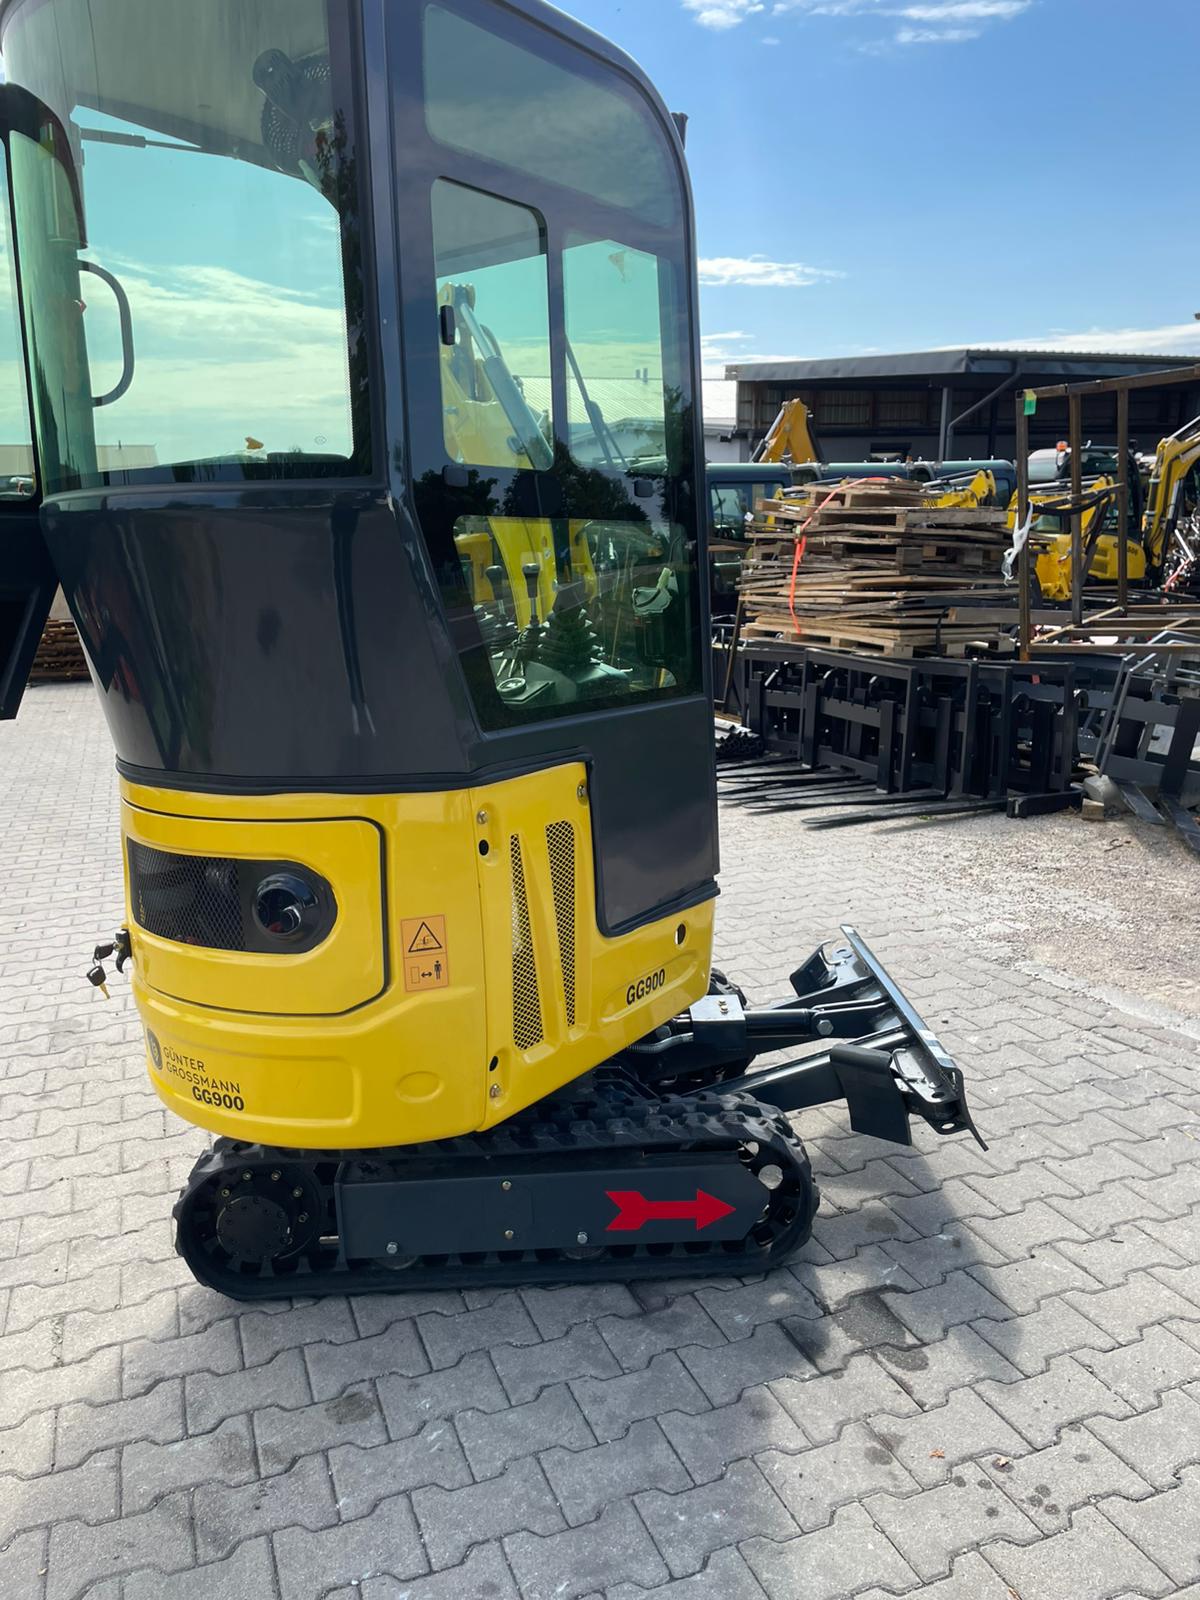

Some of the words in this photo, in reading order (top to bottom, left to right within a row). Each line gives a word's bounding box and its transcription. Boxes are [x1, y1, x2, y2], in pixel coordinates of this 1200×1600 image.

[626, 968, 666, 1006] GG900
[163, 1046, 206, 1072] GÜNTER
[166, 1061, 241, 1094] GROSSMANN
[192, 1085, 244, 1111] GG900
